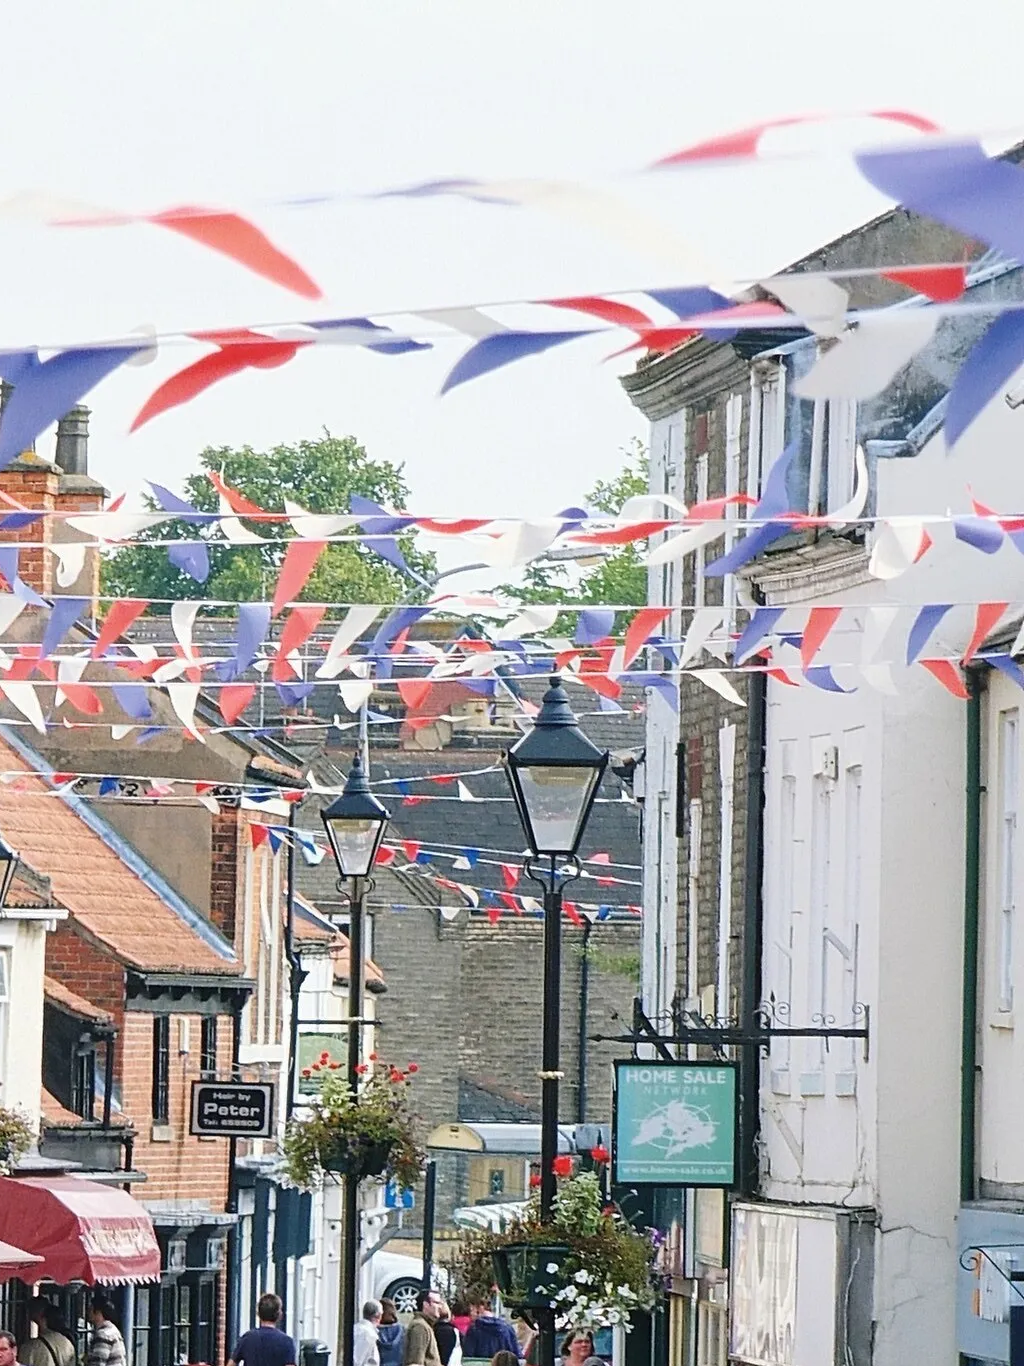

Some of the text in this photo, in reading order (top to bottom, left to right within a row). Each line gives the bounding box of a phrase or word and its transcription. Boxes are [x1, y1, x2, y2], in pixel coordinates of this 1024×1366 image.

[626, 1069, 727, 1084] HOME SALE
[212, 1092, 251, 1102] Hair by
[642, 1085, 708, 1097] NETWORK
[203, 1102, 260, 1117] Peter
